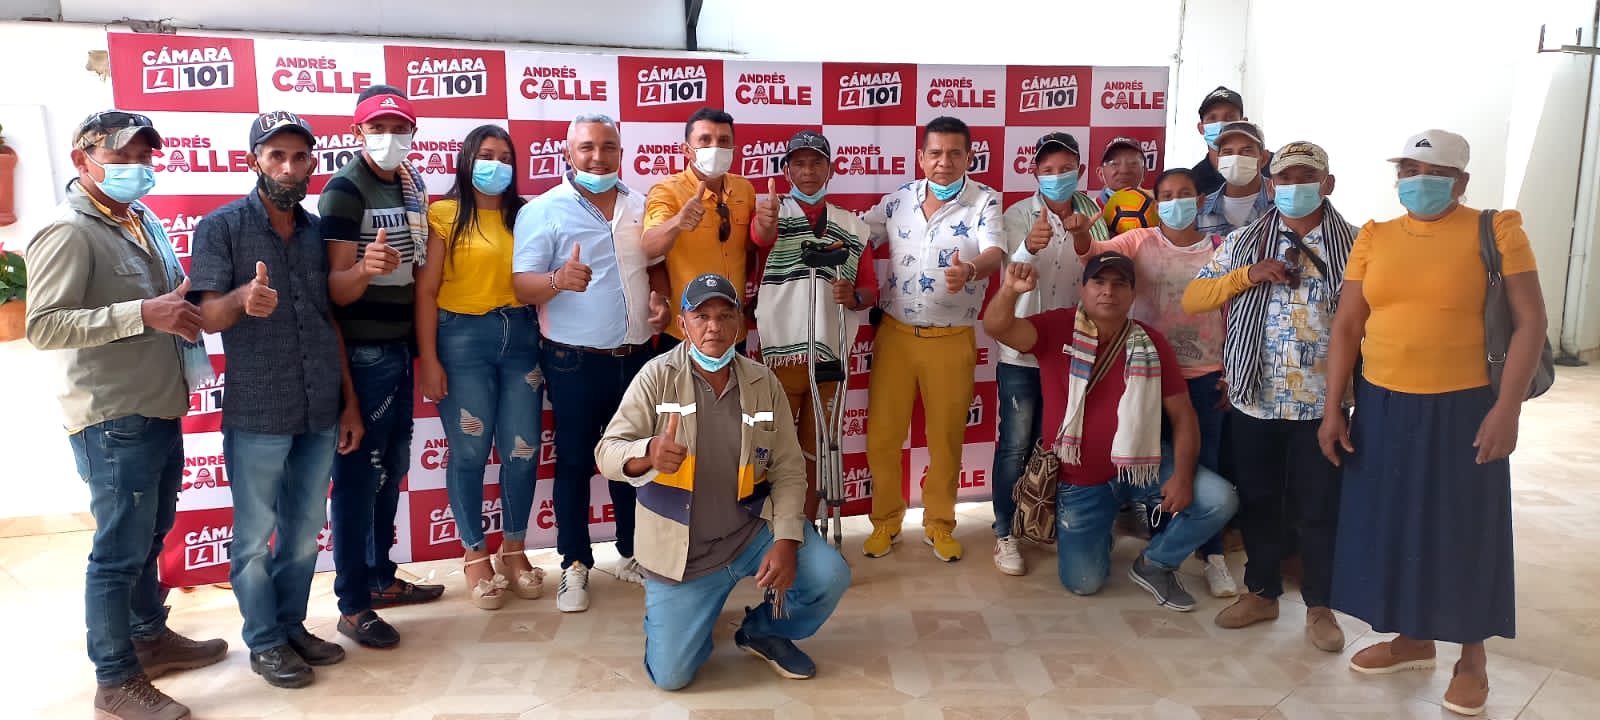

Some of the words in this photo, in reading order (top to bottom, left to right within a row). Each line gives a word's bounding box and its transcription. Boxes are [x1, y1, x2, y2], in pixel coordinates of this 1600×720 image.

[142, 46, 233, 65] CÁMARA
[275, 56, 337, 70] ANDRÉS
[407, 57, 486, 74] CÁMARA
[523, 66, 577, 78] ANDRÉS
[638, 65, 706, 82] CÁMARA
[183, 64, 229, 87] 101
[272, 70, 371, 94] CALLE
[739, 72, 786, 84] ANDRÉS
[839, 71, 901, 87] CÁMARA
[930, 79, 972, 88] ANDRÉS
[1021, 74, 1077, 91] CÁMARA
[442, 74, 483, 95] 101
[520, 79, 607, 101] CALLE
[668, 81, 703, 101] 101
[1104, 80, 1143, 90] ANDRÉS
[735, 84, 812, 105] CALLE
[866, 86, 899, 105] 101
[927, 89, 996, 108] CALLE
[1045, 89, 1074, 107] 101
[1101, 91, 1164, 110] CALLE
[160, 135, 211, 148] NDRÉS
[530, 138, 567, 154] CÁM
[742, 140, 788, 156] CÁMA
[837, 145, 881, 155] ANDRÉS
[833, 156, 905, 175] CALLE
[160, 213, 202, 231] CÁM
